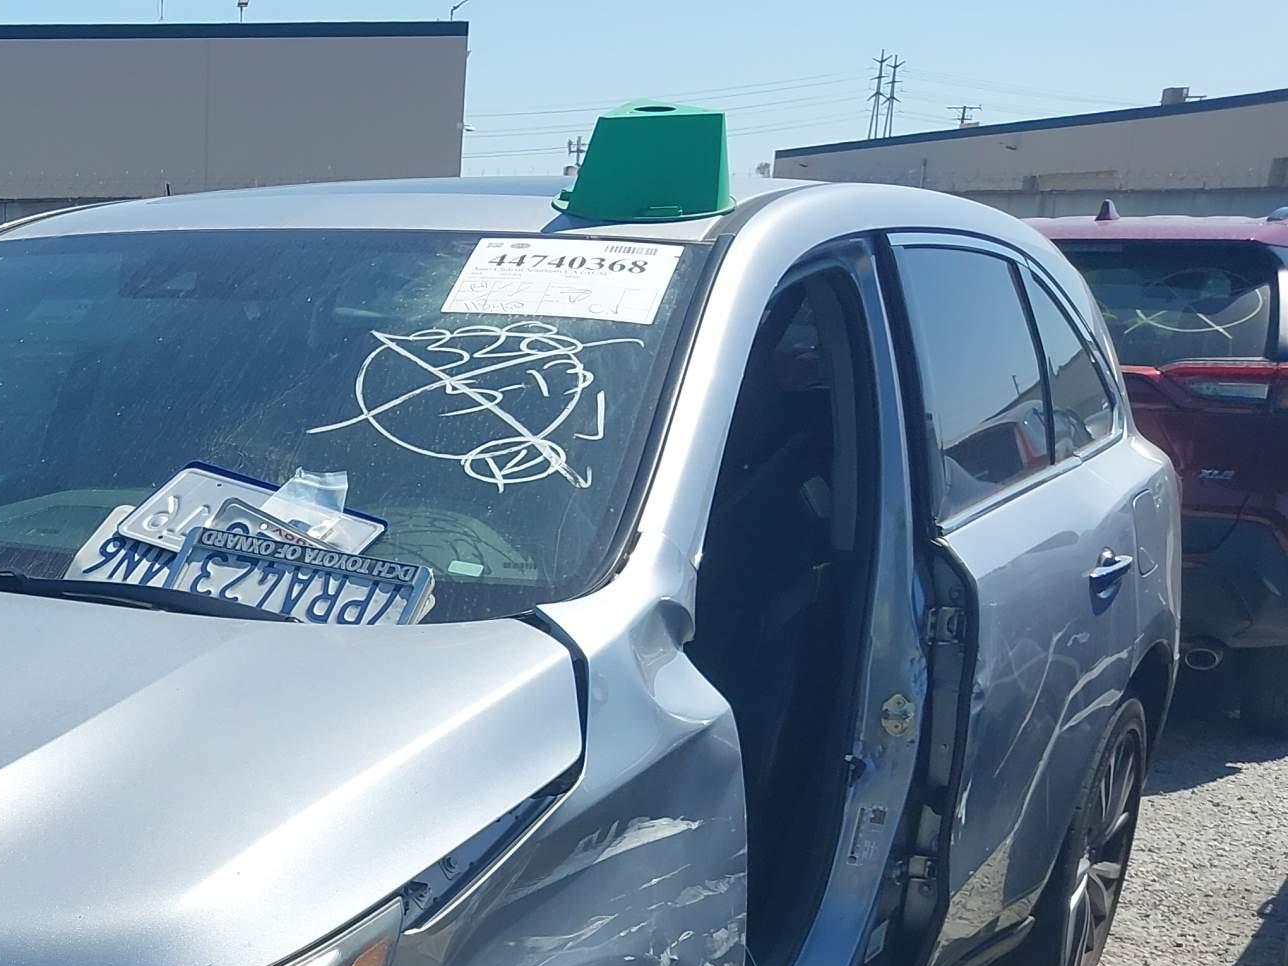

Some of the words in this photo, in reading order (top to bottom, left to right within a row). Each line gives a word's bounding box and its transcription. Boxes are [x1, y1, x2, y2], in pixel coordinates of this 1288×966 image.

[487, 253, 649, 274] 44740368
[201, 530, 276, 555] OXNARD
[276, 544, 302, 561] OF
[303, 548, 372, 574] TOYOTA
[374, 561, 415, 582] DCH
